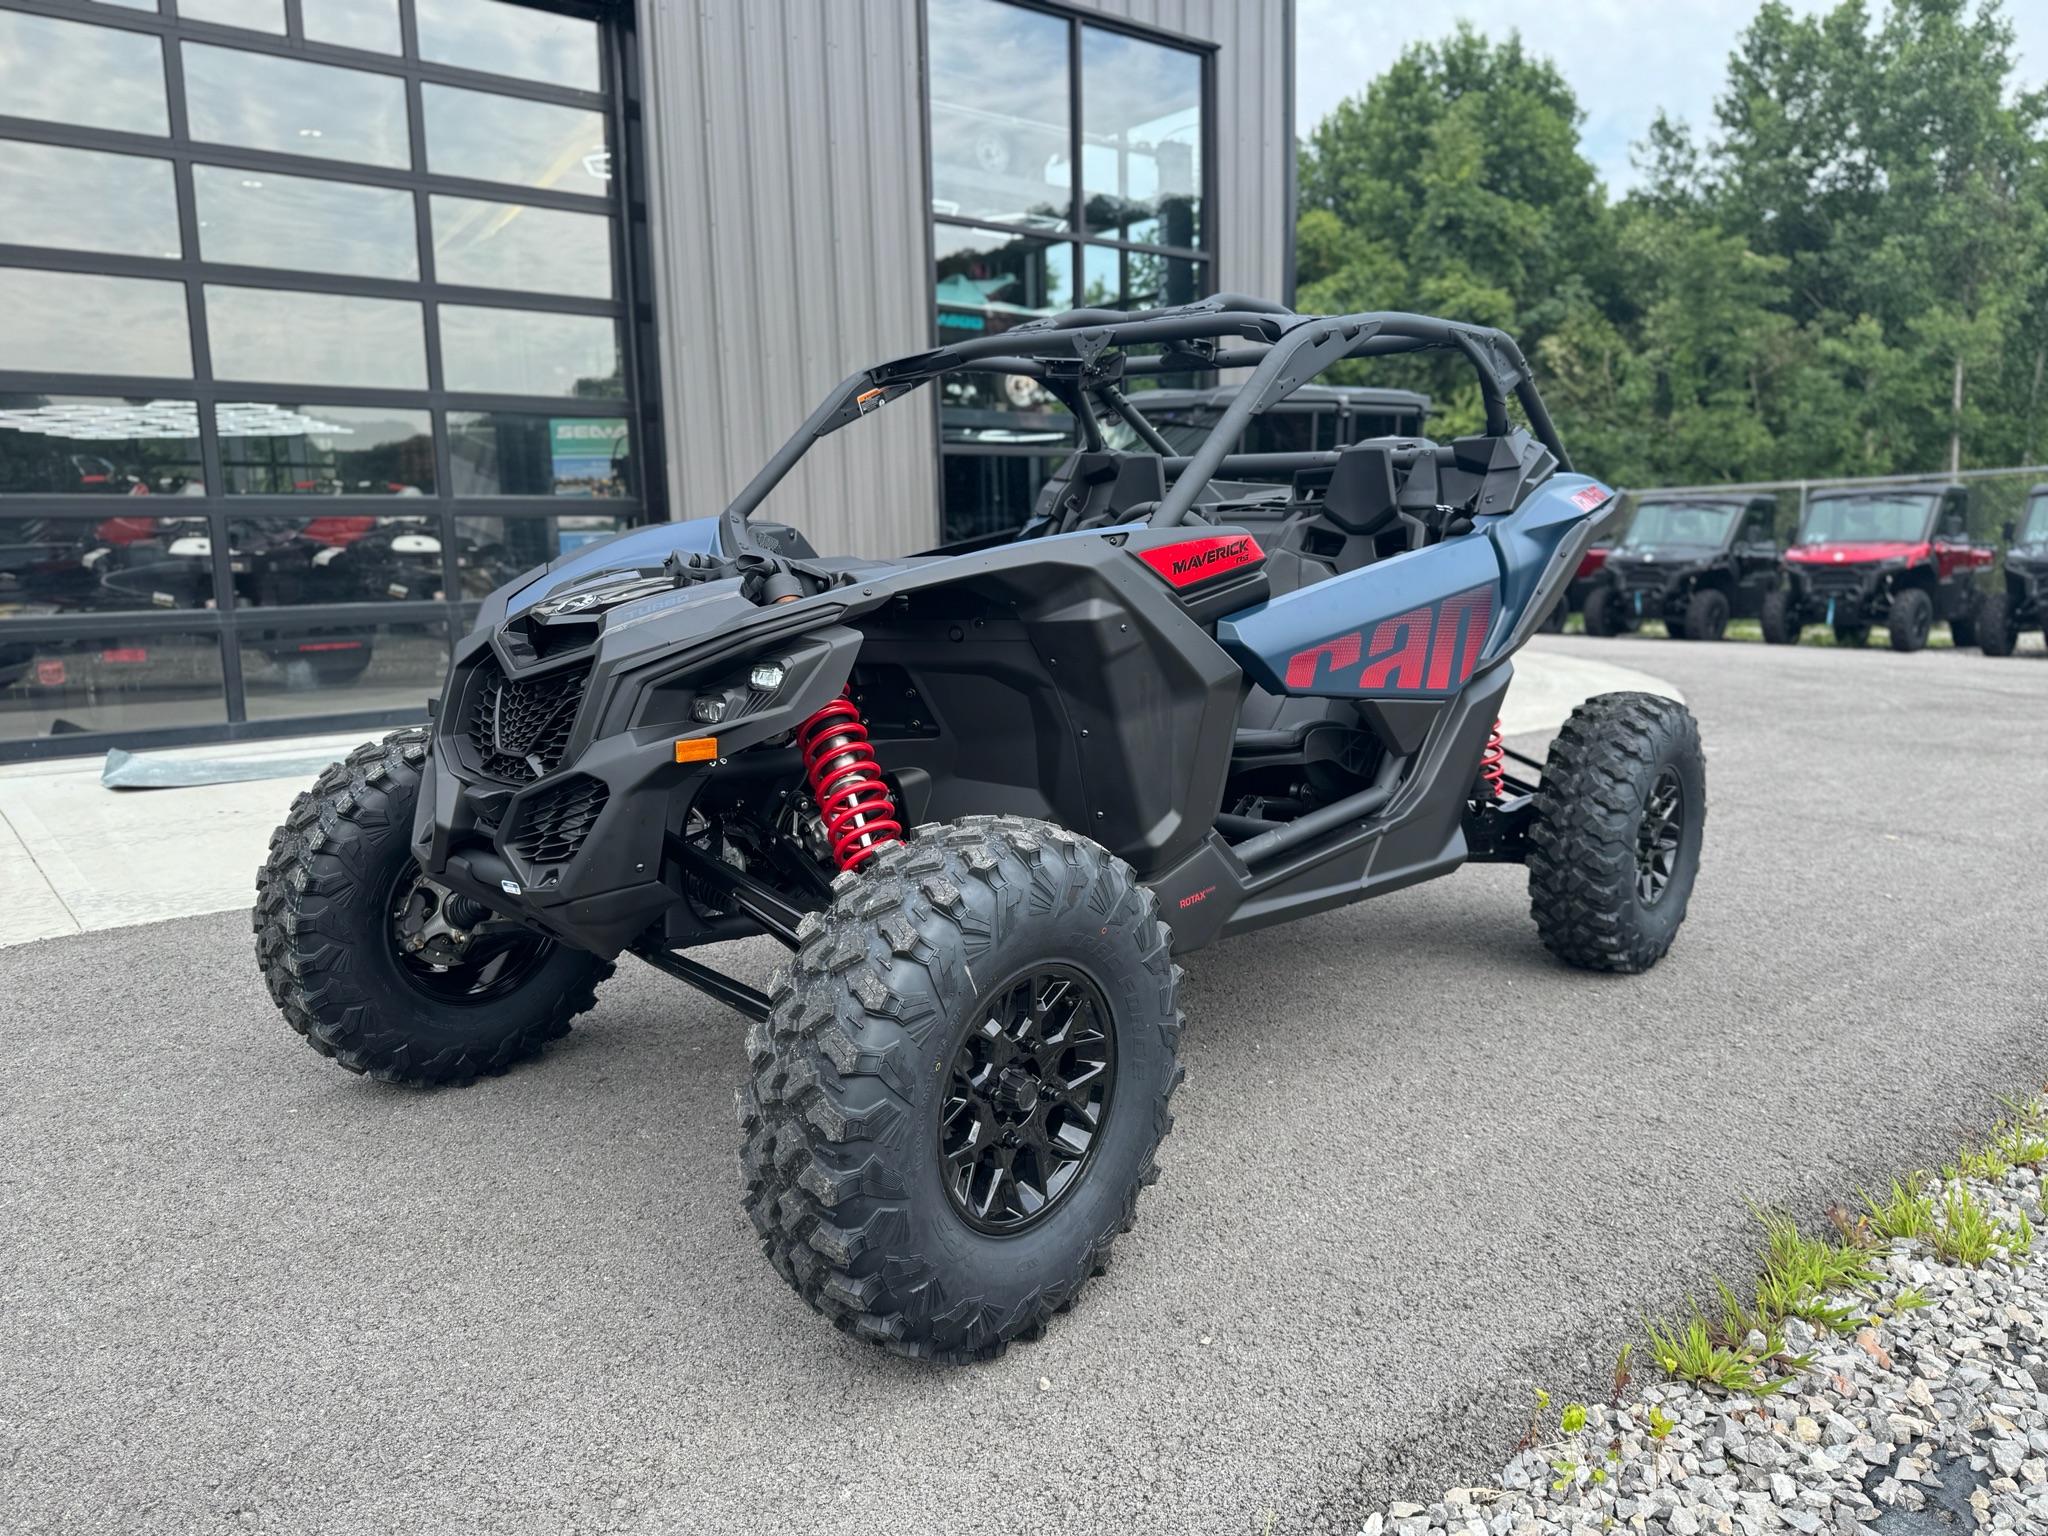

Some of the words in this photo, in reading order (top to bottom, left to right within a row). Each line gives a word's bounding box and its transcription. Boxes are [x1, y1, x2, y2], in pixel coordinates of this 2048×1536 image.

[1172, 538, 1249, 575] MAVERICK
[1235, 554, 1249, 564] RS
[625, 594, 689, 618] TURBO
[1179, 890, 1206, 909] ROTAX
[1117, 974, 1148, 1082] FORCE
